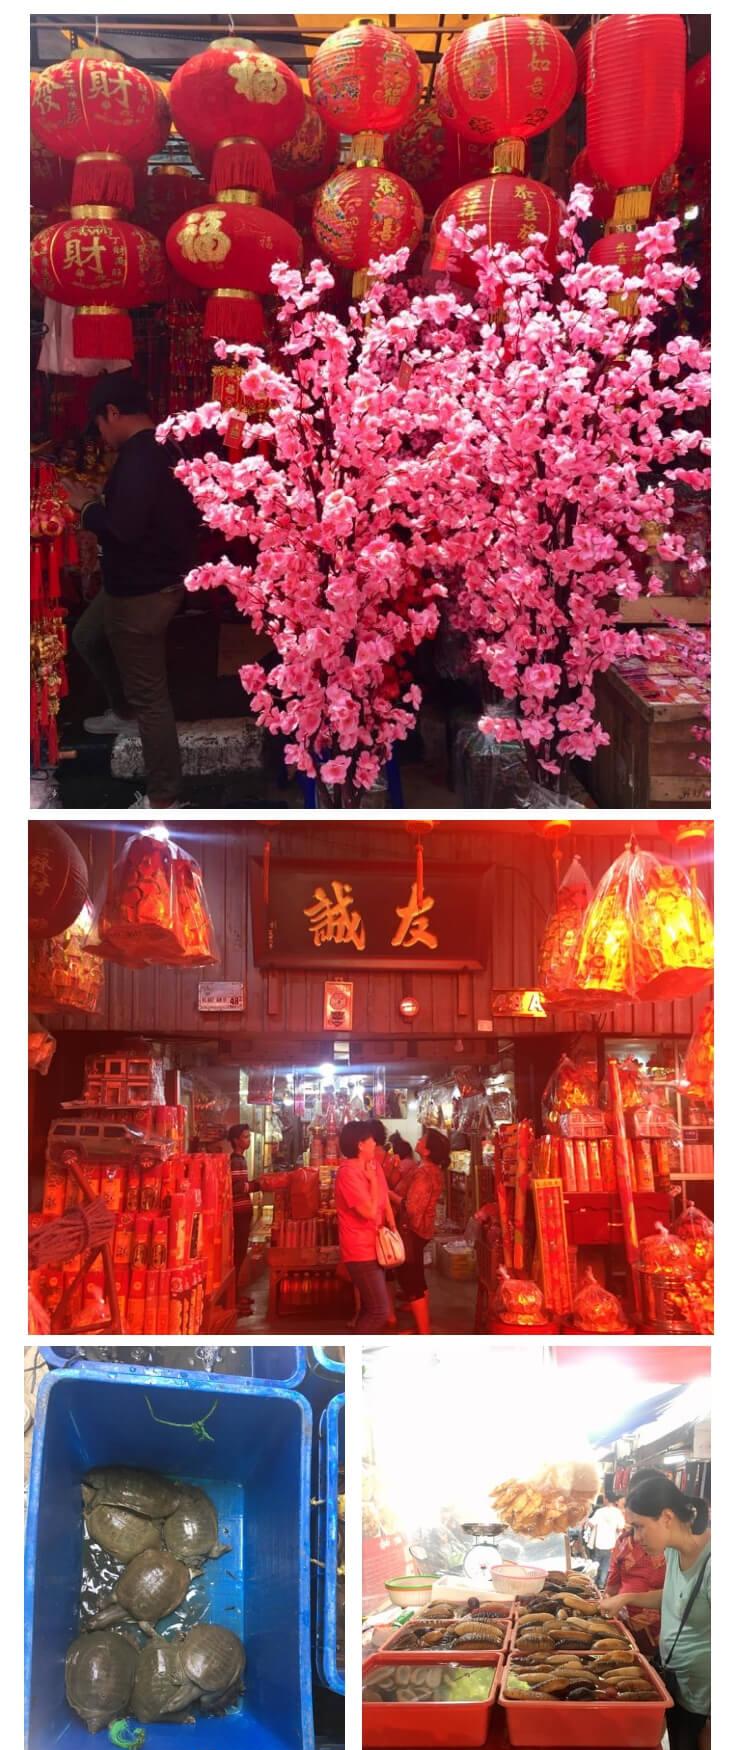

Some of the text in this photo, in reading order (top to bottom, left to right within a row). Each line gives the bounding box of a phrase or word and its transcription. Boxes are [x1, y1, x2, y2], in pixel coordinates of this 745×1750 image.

[88, 70, 132, 108] 財
[228, 52, 287, 105] 福
[64, 236, 106, 274] 財
[176, 209, 231, 263] 福
